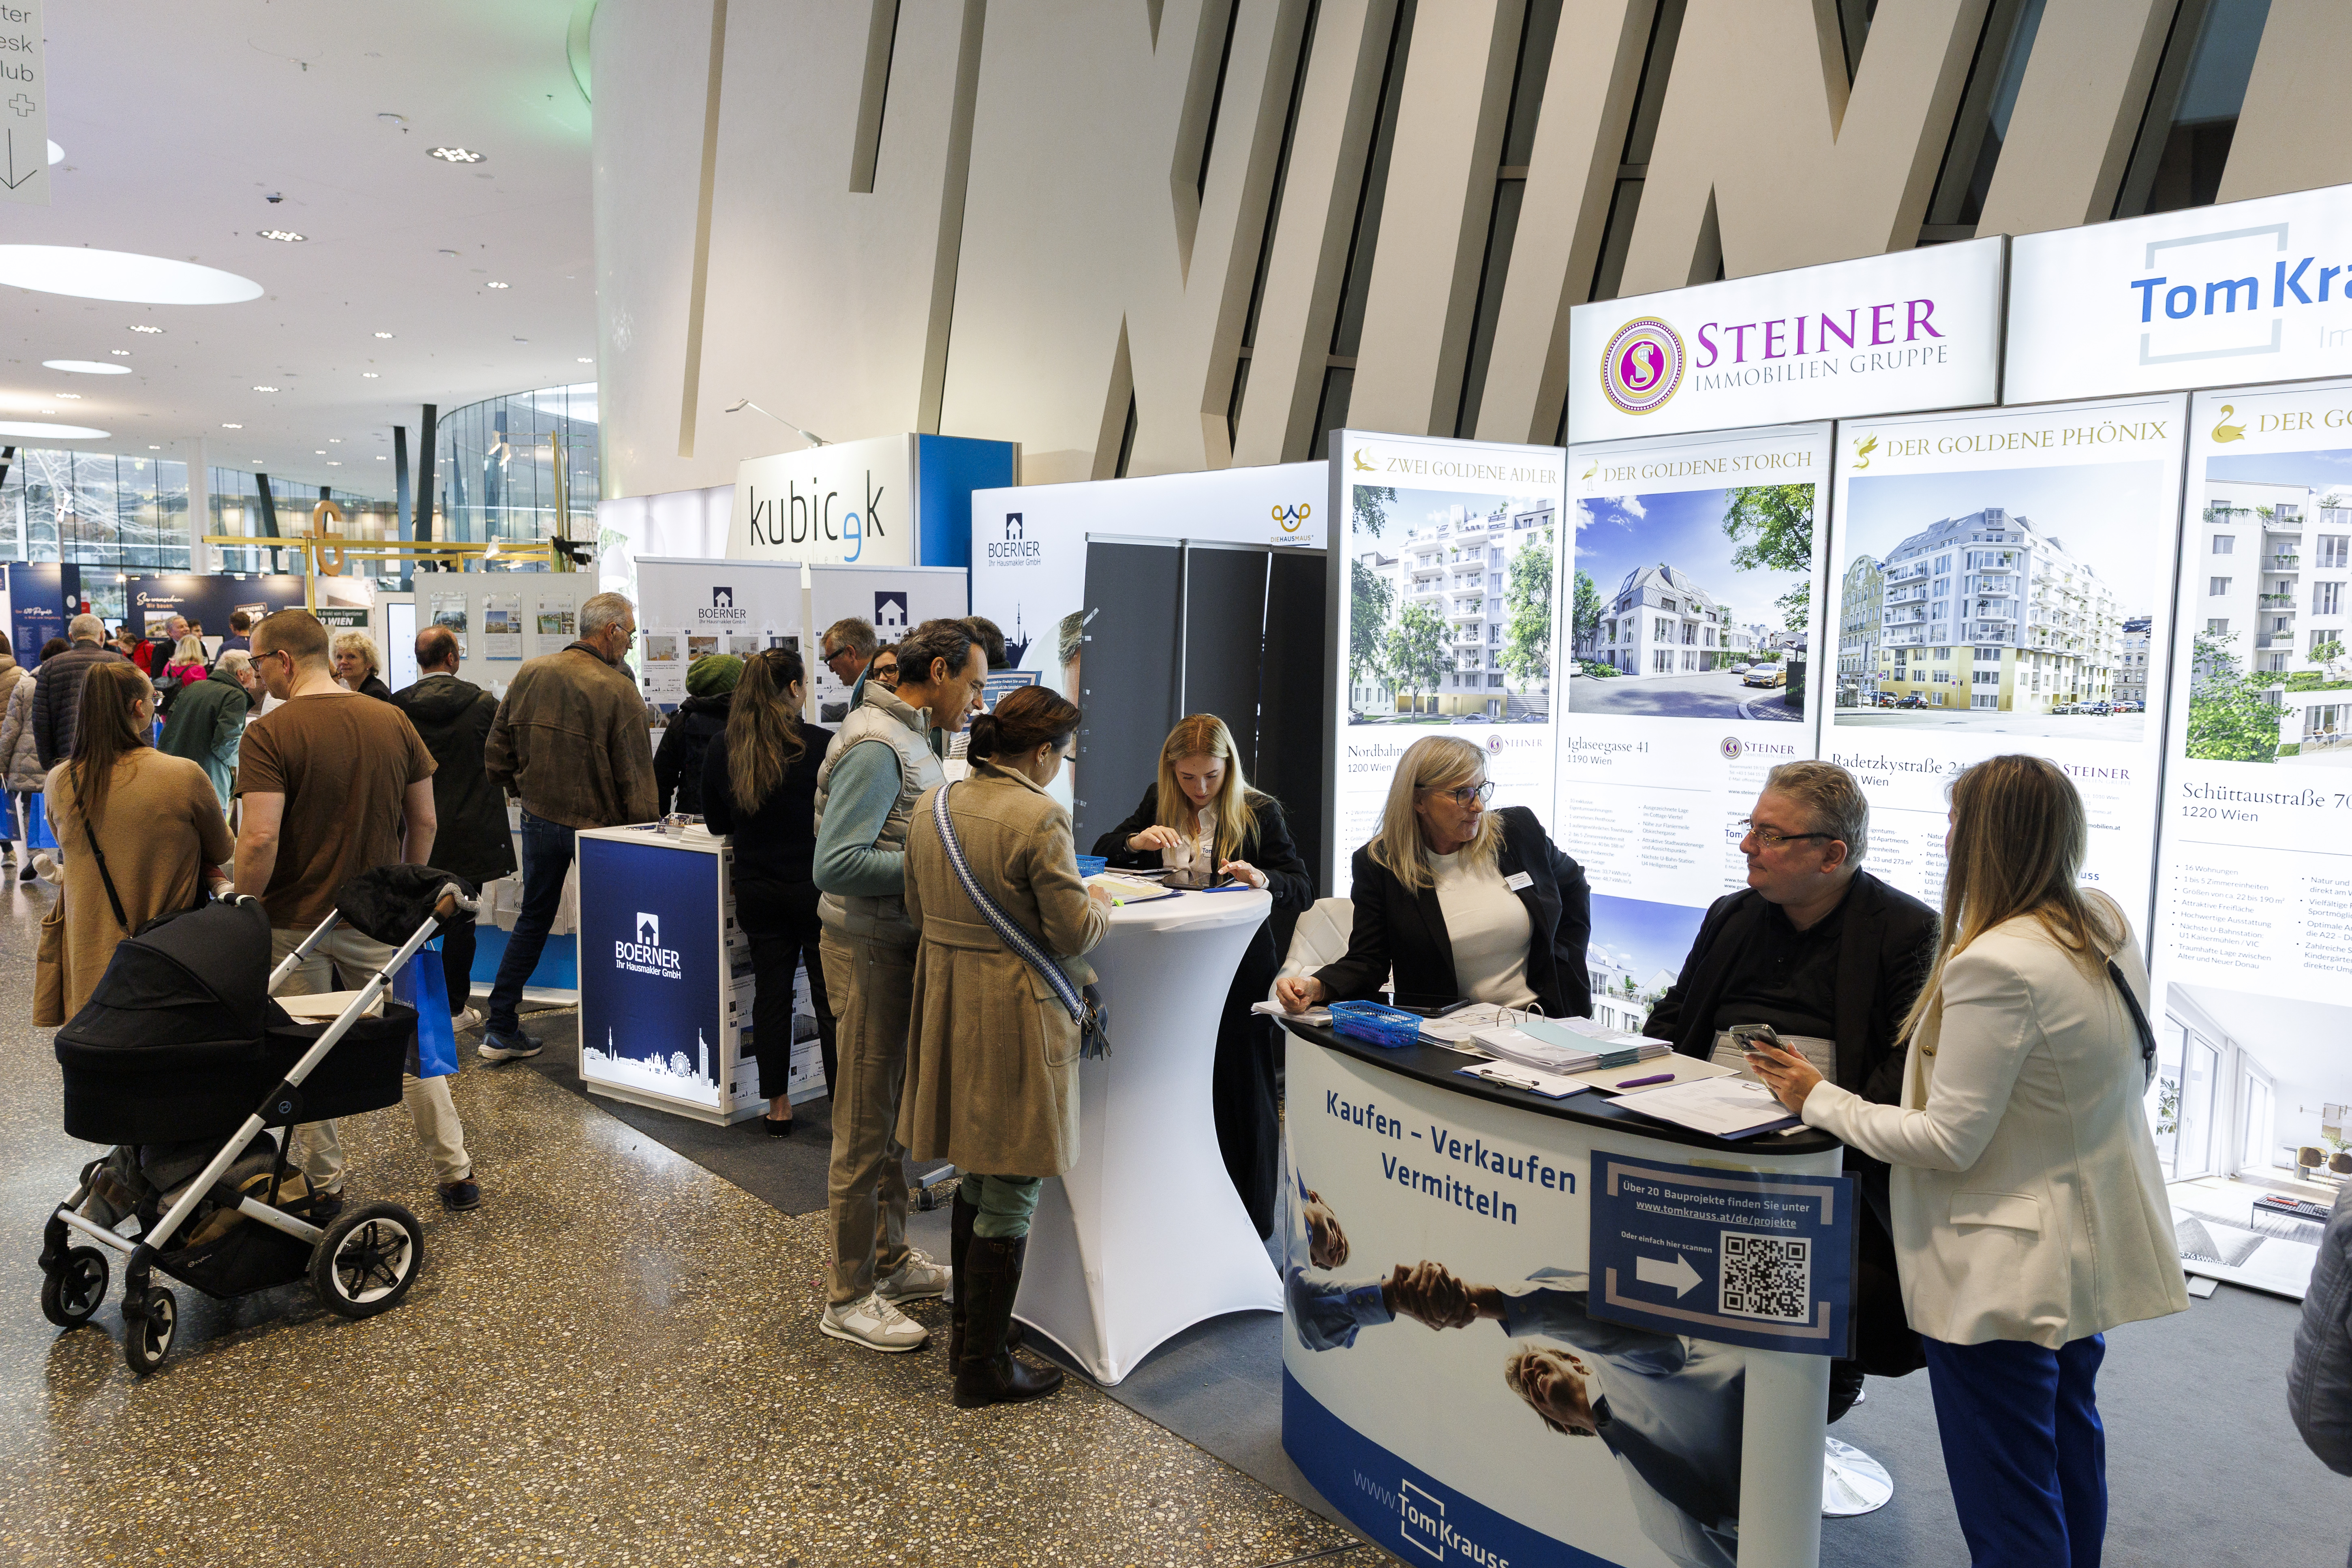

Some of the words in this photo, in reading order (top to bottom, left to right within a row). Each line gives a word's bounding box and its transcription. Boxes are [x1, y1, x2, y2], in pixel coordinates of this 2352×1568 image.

[0, 5, 31, 23] ter
[1, 60, 33, 81] lub
[1696, 299, 1945, 368] STEINER
[1695, 358, 1838, 391] IMMOBILIEN
[1850, 344, 1948, 373] GRUPPE
[2259, 412, 2315, 432] DER
[1887, 439, 1930, 457] DER
[1938, 430, 2054, 453] GOLDENE
[2062, 421, 2168, 446] PHÖNIX
[1387, 458, 1427, 475] ZWEI
[1433, 461, 1506, 480] GOLDENE
[1510, 468, 1557, 484] ADLER
[1604, 467, 1637, 482] DER
[1642, 458, 1727, 479] GOLDENE
[1732, 451, 1812, 471] STORCH
[989, 541, 1040, 557] BOERNER
[328, 617, 353, 625] WIEN
[699, 609, 746, 618] BOERNER
[1505, 739, 1542, 747] STEINER
[1568, 736, 1632, 755] Iglaseegasse
[1637, 742, 1649, 753] 41
[1744, 741, 1796, 754] STEINER
[1348, 764, 1368, 772] 1200
[1568, 755, 1588, 763] 1190
[1591, 756, 1612, 765] Wien
[1832, 754, 1942, 775] Radetzkystraße
[2064, 764, 2130, 779] STEINER
[1861, 775, 1889, 786] Wien
[2183, 782, 2325, 806] Schüttaustraße
[1570, 805, 1613, 813] Eigentumswohnungen
[2182, 806, 2217, 818] 1220
[2221, 809, 2258, 822] Wien
[1665, 840, 1704, 849] Stadtwanderwege
[2195, 866, 2238, 875] Wohnungen
[2207, 879, 2269, 890] Zimmereinheiten
[2182, 900, 2217, 909] Attraktive
[2219, 904, 2254, 913] Freifläche
[2309, 898, 2348, 909] Vielfältige
[2181, 911, 2226, 922] Hochwertige
[2227, 917, 2271, 928] Ausstattung
[2307, 920, 2343, 930] Optimale
[2180, 923, 2209, 932] Nächste
[2210, 927, 2264, 939] U-Bahnstation:
[2191, 934, 2240, 945] Kaisermühlen
[2305, 942, 2346, 952] Zahlreiche
[616, 941, 681, 969] BOERNER
[2179, 943, 2218, 954] Traumhafte
[2238, 953, 2271, 961] zwischen
[2305, 952, 2352, 963] Kindergärte
[616, 959, 625, 969] Ihr
[626, 961, 661, 975] Hausmakler
[662, 968, 681, 979] GmbH
[2235, 960, 2259, 969] Donau
[2304, 962, 2334, 970] direkter
[1327, 1089, 1402, 1139] Kaufen
[1431, 1125, 1576, 1194] Verkaufen
[1381, 1152, 1517, 1225] Vermitteln
[1623, 1180, 1645, 1194] Über
[1648, 1187, 1659, 1196] 20
[1665, 1189, 1725, 1205] Bauprojekte
[1727, 1198, 1761, 1209] finden
[1764, 1201, 1779, 1210] Sie
[1782, 1203, 1810, 1212] unter
[1636, 1201, 1797, 1228] www.tomkrauss.at/de/projekte
[1621, 1231, 1637, 1241] Oder
[1639, 1234, 1665, 1246] einfach
[1666, 1240, 1681, 1249] hier
[1682, 1243, 1712, 1254] scannen
